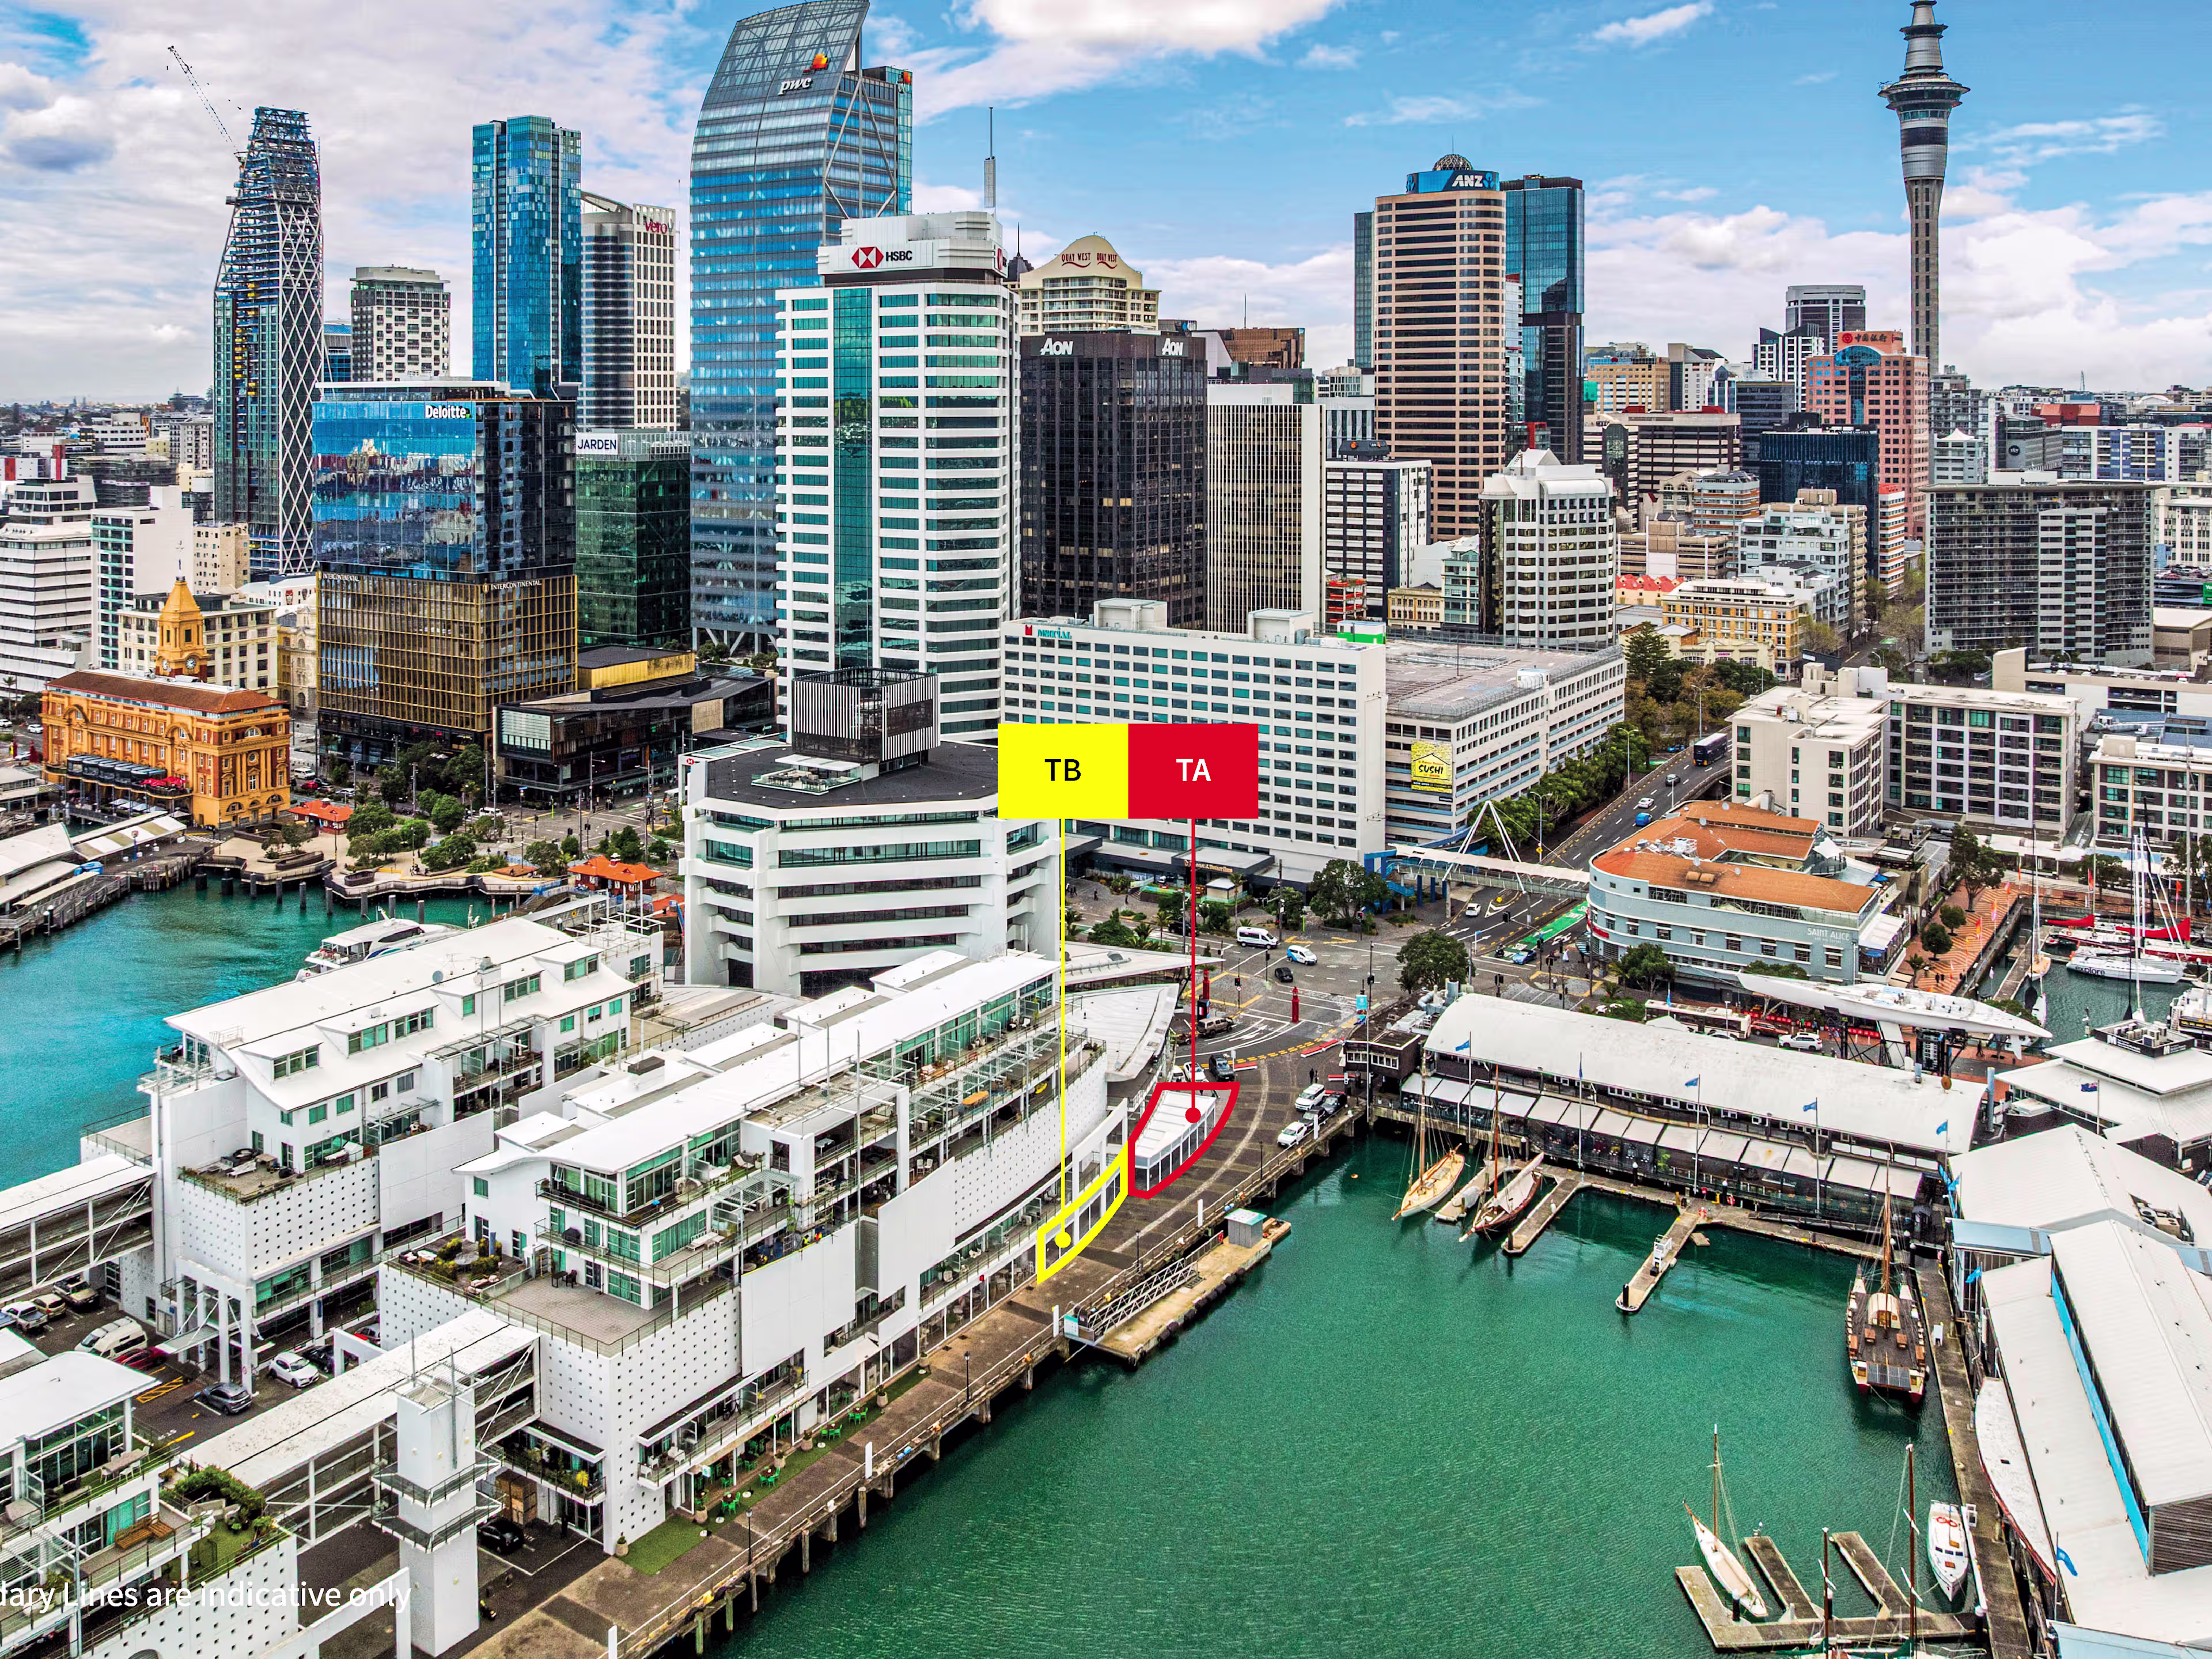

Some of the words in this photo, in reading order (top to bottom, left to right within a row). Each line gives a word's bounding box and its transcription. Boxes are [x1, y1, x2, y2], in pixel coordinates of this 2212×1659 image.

[778, 78, 812, 95] pwc
[1452, 175, 1483, 187] ANZ
[645, 221, 668, 234] vero
[885, 251, 912, 262] HSBC
[1062, 253, 1075, 262] QUAY
[1097, 253, 1107, 262] QUAY
[578, 439, 616, 449] JARDEN
[1419, 764, 1444, 774] SUSHI
[1807, 927, 1828, 937] SAINT
[1830, 930, 1850, 941] ALICE
[2075, 966, 2105, 976] explore
